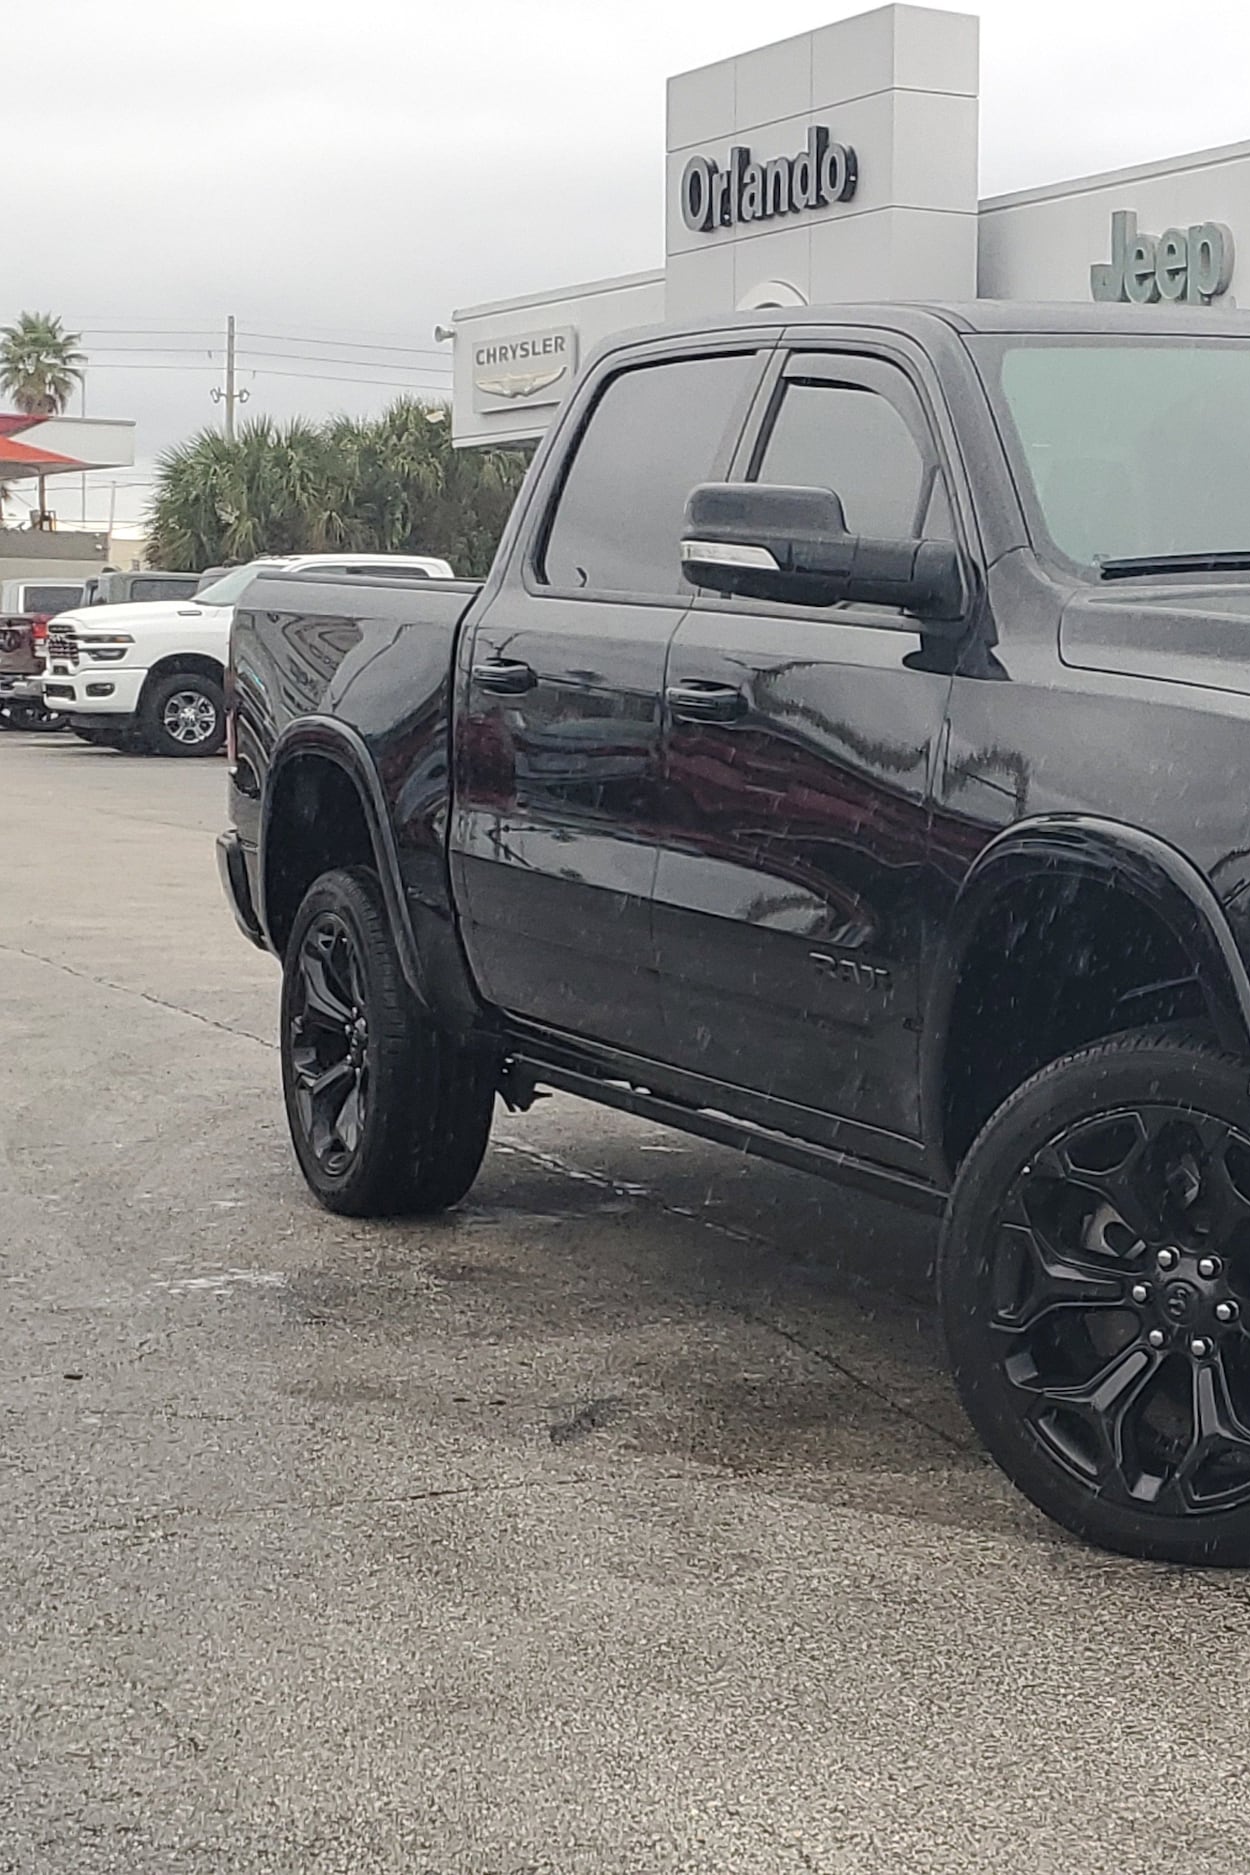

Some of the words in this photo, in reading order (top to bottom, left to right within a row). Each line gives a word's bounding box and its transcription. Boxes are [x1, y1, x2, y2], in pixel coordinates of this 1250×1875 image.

[681, 125, 858, 232] Orlando
[1090, 210, 1235, 305] Jeep
[476, 335, 565, 366] CHRYSLER
[808, 951, 894, 990] RAM
